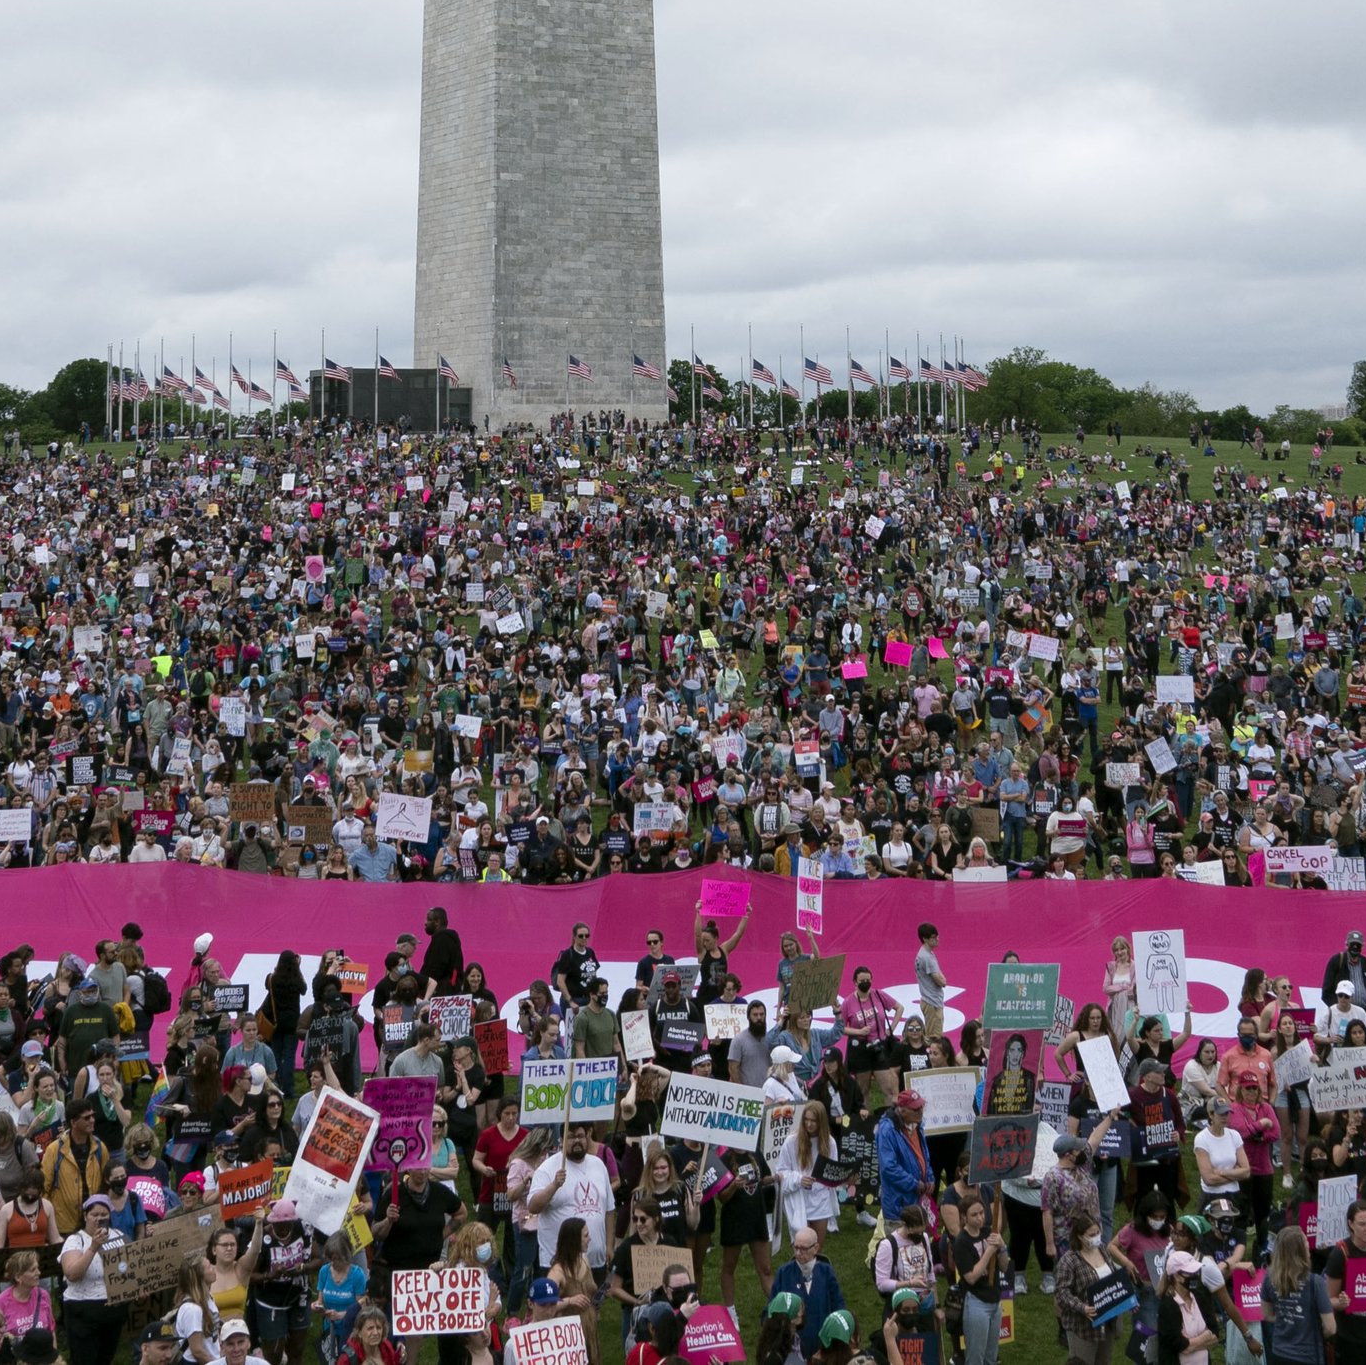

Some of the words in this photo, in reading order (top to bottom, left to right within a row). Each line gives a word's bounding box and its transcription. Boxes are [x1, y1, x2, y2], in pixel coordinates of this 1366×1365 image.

[73, 756, 94, 764] STAND
[239, 785, 271, 794] SUPPORT
[231, 801, 259, 811] RIGHT
[261, 802, 272, 810] TO
[763, 813, 779, 822] DARE
[1266, 848, 1309, 859] CANCEL
[1300, 856, 1329, 868] GOP
[1003, 973, 1045, 984] ABORTION
[430, 995, 471, 1009] Mother
[996, 1000, 1047, 1012] HEALTHCARE
[440, 1006, 470, 1019] CHOICE
[384, 1021, 414, 1034] PROTECT
[442, 1017, 471, 1036] CHOICE
[668, 1026, 690, 1036] Abortion
[689, 1028, 698, 1036] is
[385, 1030, 410, 1042] CHOICE
[667, 1032, 685, 1041] Health
[684, 1033, 699, 1042] Care.
[524, 1064, 566, 1079] THEIR
[575, 1059, 616, 1076] THEIR
[408, 1090, 426, 1099] THE
[524, 1082, 568, 1112] BODY
[993, 1095, 1027, 1104] ABORTION
[1040, 1086, 1065, 1101] WHEN
[667, 1084, 684, 1103] NO
[684, 1088, 719, 1108] PERSON
[722, 1093, 735, 1111] IS
[735, 1097, 763, 1119] FREE
[181, 1120, 207, 1128] Abortion
[664, 1106, 706, 1127] WITHOUT
[703, 1111, 761, 1136] AUTONOMY
[1145, 1120, 1175, 1134] PROTECT
[180, 1126, 200, 1134] Health
[312, 1121, 331, 1141] THE
[982, 1129, 1032, 1147] VETO
[1146, 1133, 1173, 1145] CHOICE
[977, 1149, 1032, 1170] ALITO
[221, 1180, 237, 1191] WE
[237, 1177, 253, 1189] ARE
[252, 1174, 264, 1185] THE
[314, 1174, 328, 1185] 2022
[102, 1246, 124, 1267] Not
[125, 1244, 156, 1261] Fragile
[158, 1237, 179, 1251] like
[129, 1260, 137, 1268] a
[146, 1266, 162, 1275] like
[136, 1274, 162, 1286] Bomb
[392, 1268, 431, 1296] KEEP
[436, 1267, 482, 1290] YOUR
[1092, 1286, 1118, 1303] Abortion
[1116, 1281, 1123, 1291] is
[393, 1291, 443, 1316] LAWS
[445, 1290, 482, 1311] OFF
[1093, 1295, 1113, 1310] Health
[1112, 1288, 1128, 1302] Care.
[396, 1314, 436, 1333] OUR
[437, 1310, 485, 1331] BODIES
[685, 1322, 717, 1336] Abortion
[717, 1322, 724, 1331] is
[513, 1327, 553, 1359] HER
[553, 1321, 584, 1351] BODY
[686, 1334, 716, 1347] Health
[716, 1330, 736, 1343] Care.
[899, 1338, 925, 1353] FIGHT
